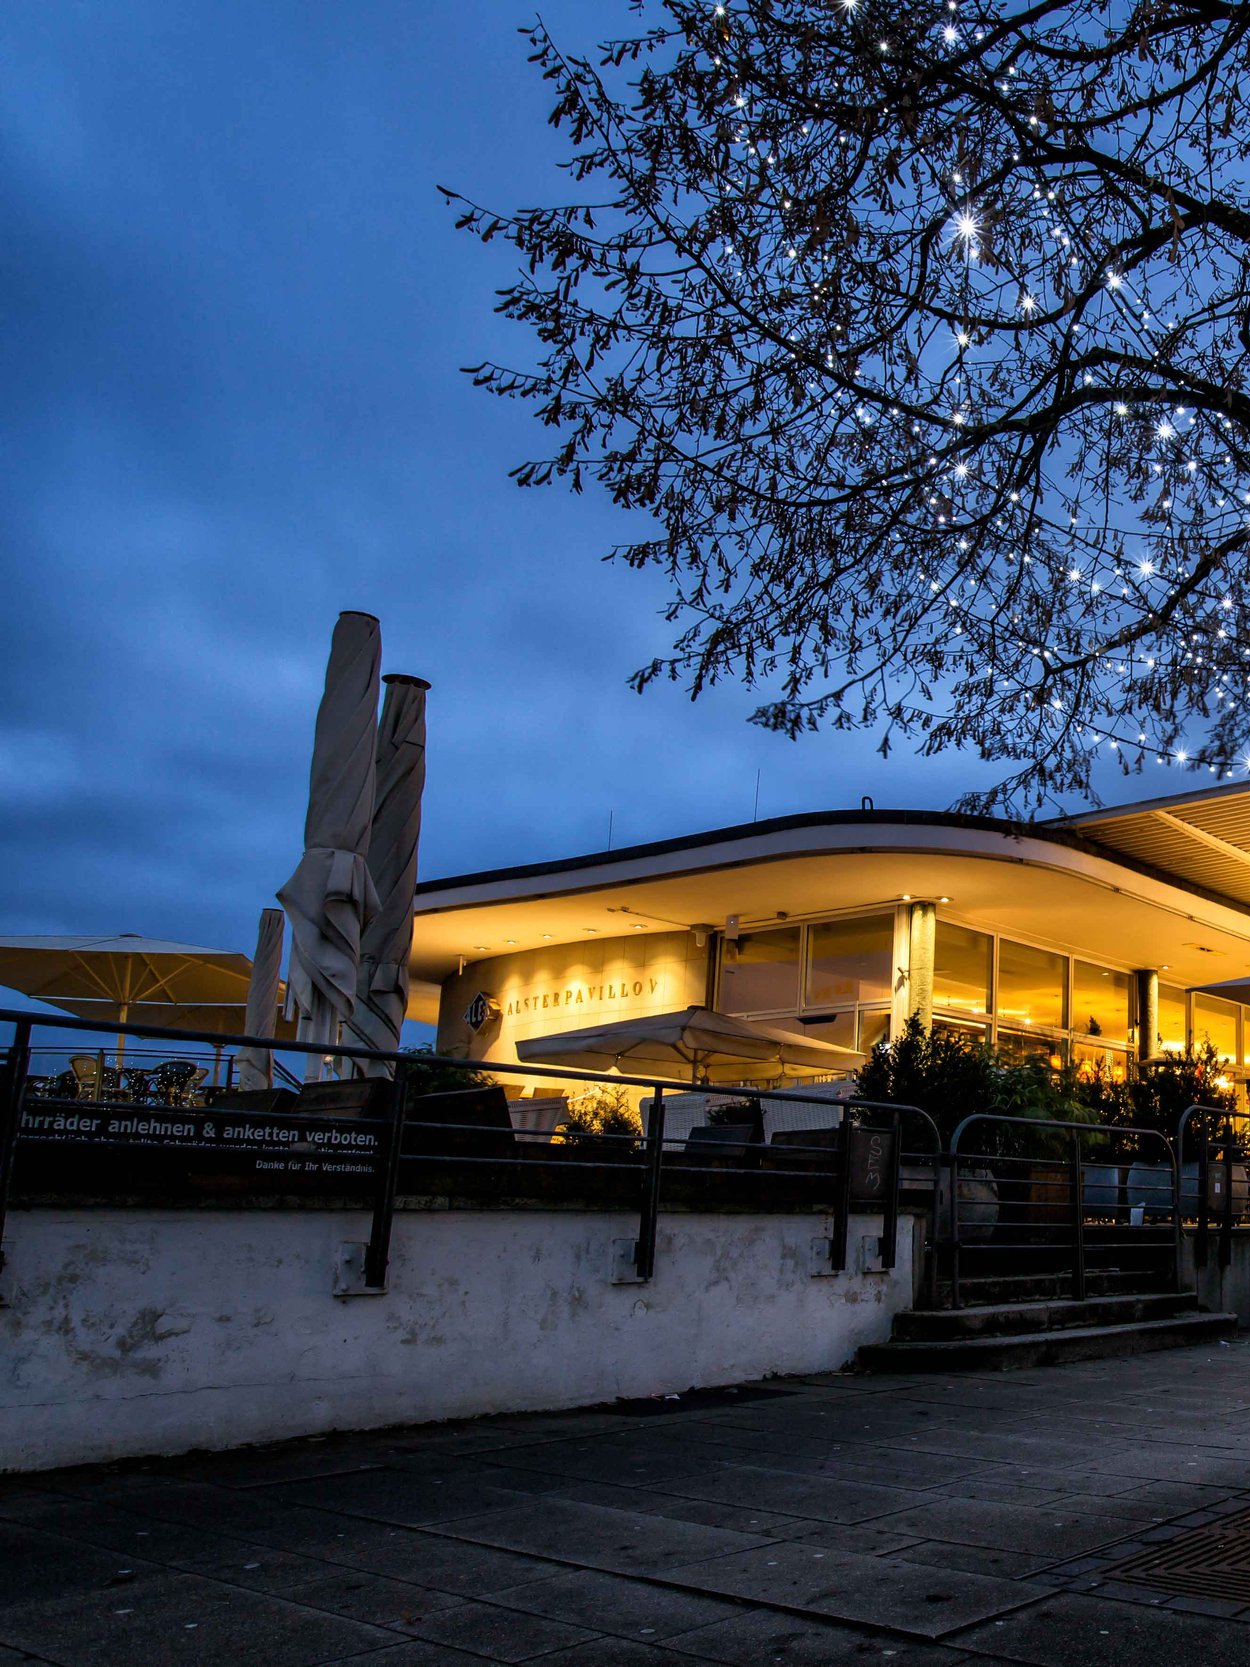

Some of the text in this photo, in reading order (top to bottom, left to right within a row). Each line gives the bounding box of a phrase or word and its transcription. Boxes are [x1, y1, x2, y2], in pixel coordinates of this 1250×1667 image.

[20, 1110, 101, 1132] hrräder
[108, 1116, 195, 1137] anlehnen
[202, 1121, 216, 1138] &
[223, 1124, 299, 1142] anketten
[305, 1129, 379, 1146] verboten.
[255, 1159, 375, 1173] Danke für Ihr Verständnis.
